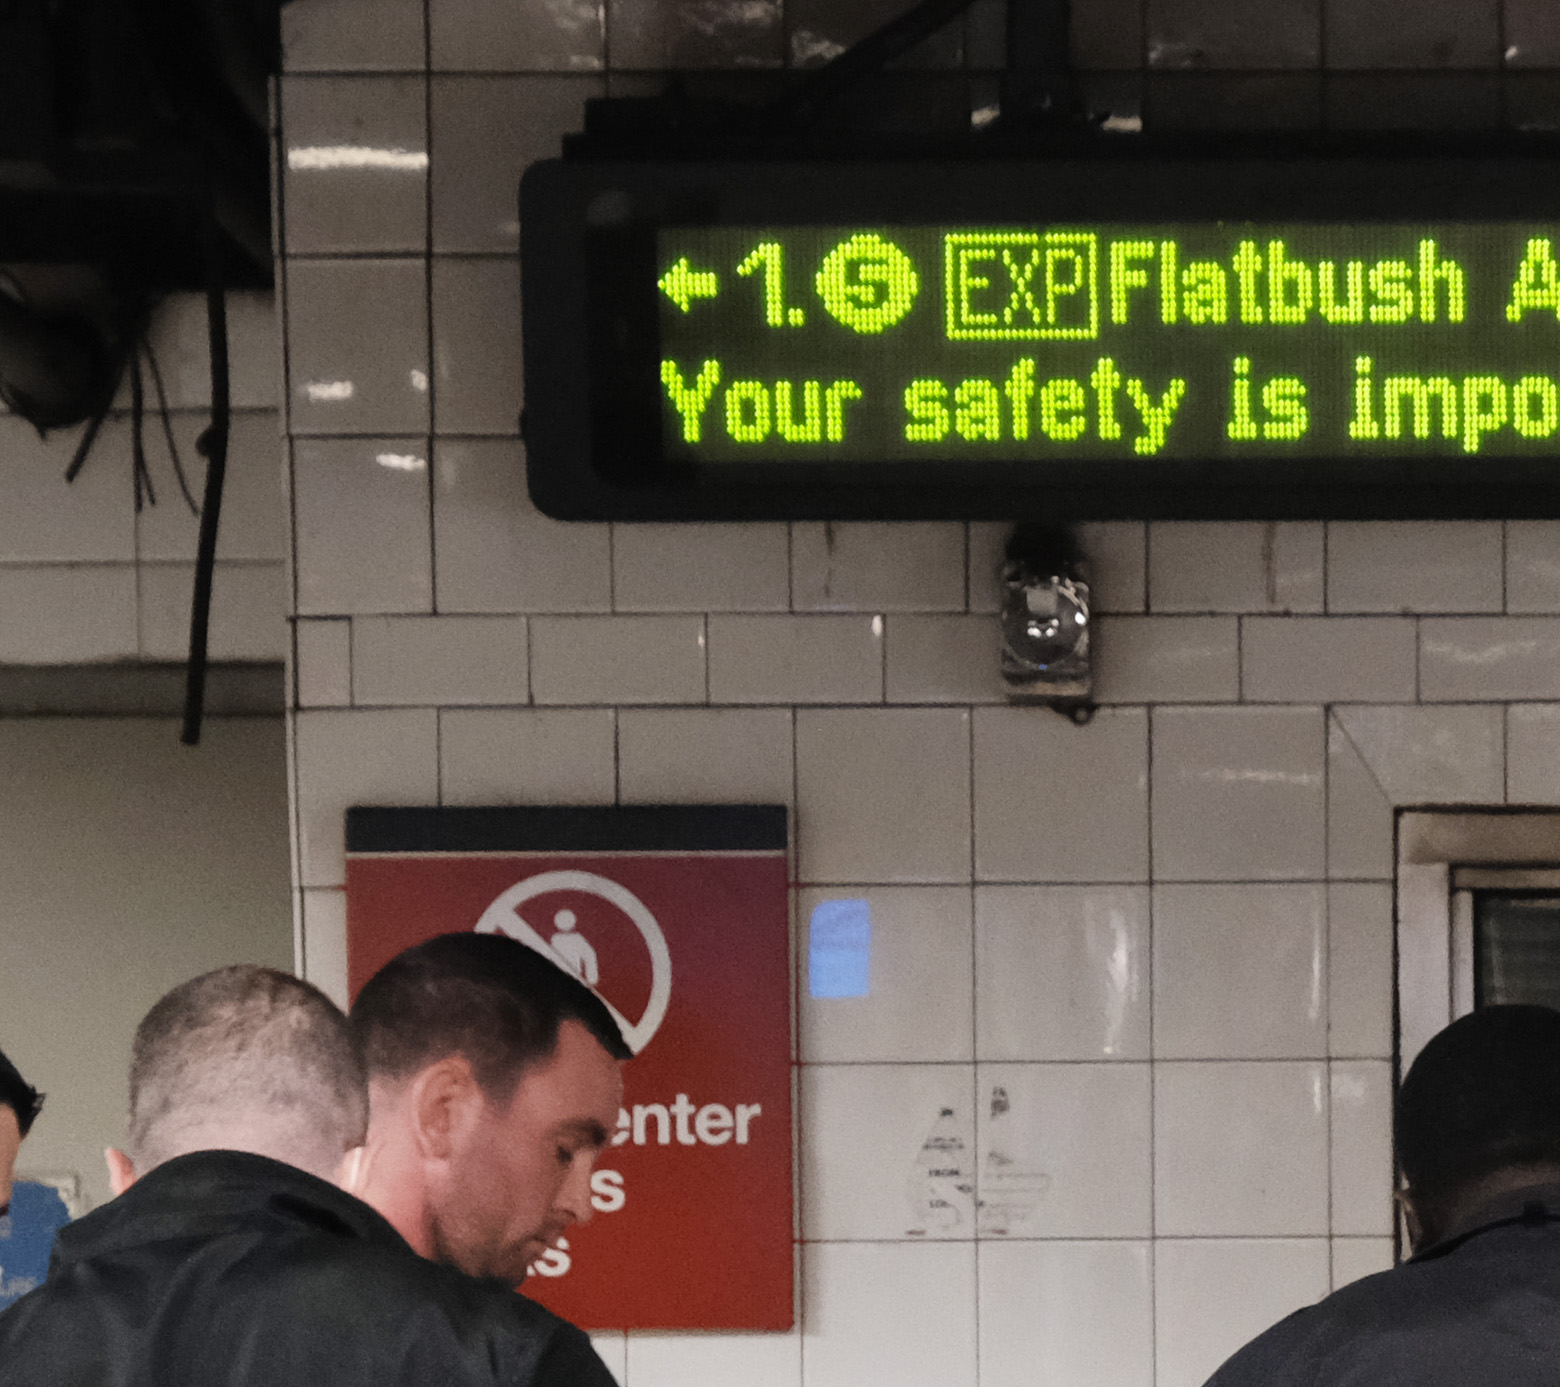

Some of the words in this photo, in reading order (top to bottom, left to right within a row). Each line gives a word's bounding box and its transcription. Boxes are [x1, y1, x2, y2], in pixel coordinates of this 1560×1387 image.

[957, 248, 1085, 326] EXP
[1108, 238, 1467, 326] Flatbush
[659, 358, 863, 444] Your
[904, 356, 1186, 456] safety
[1227, 356, 1310, 442] is
